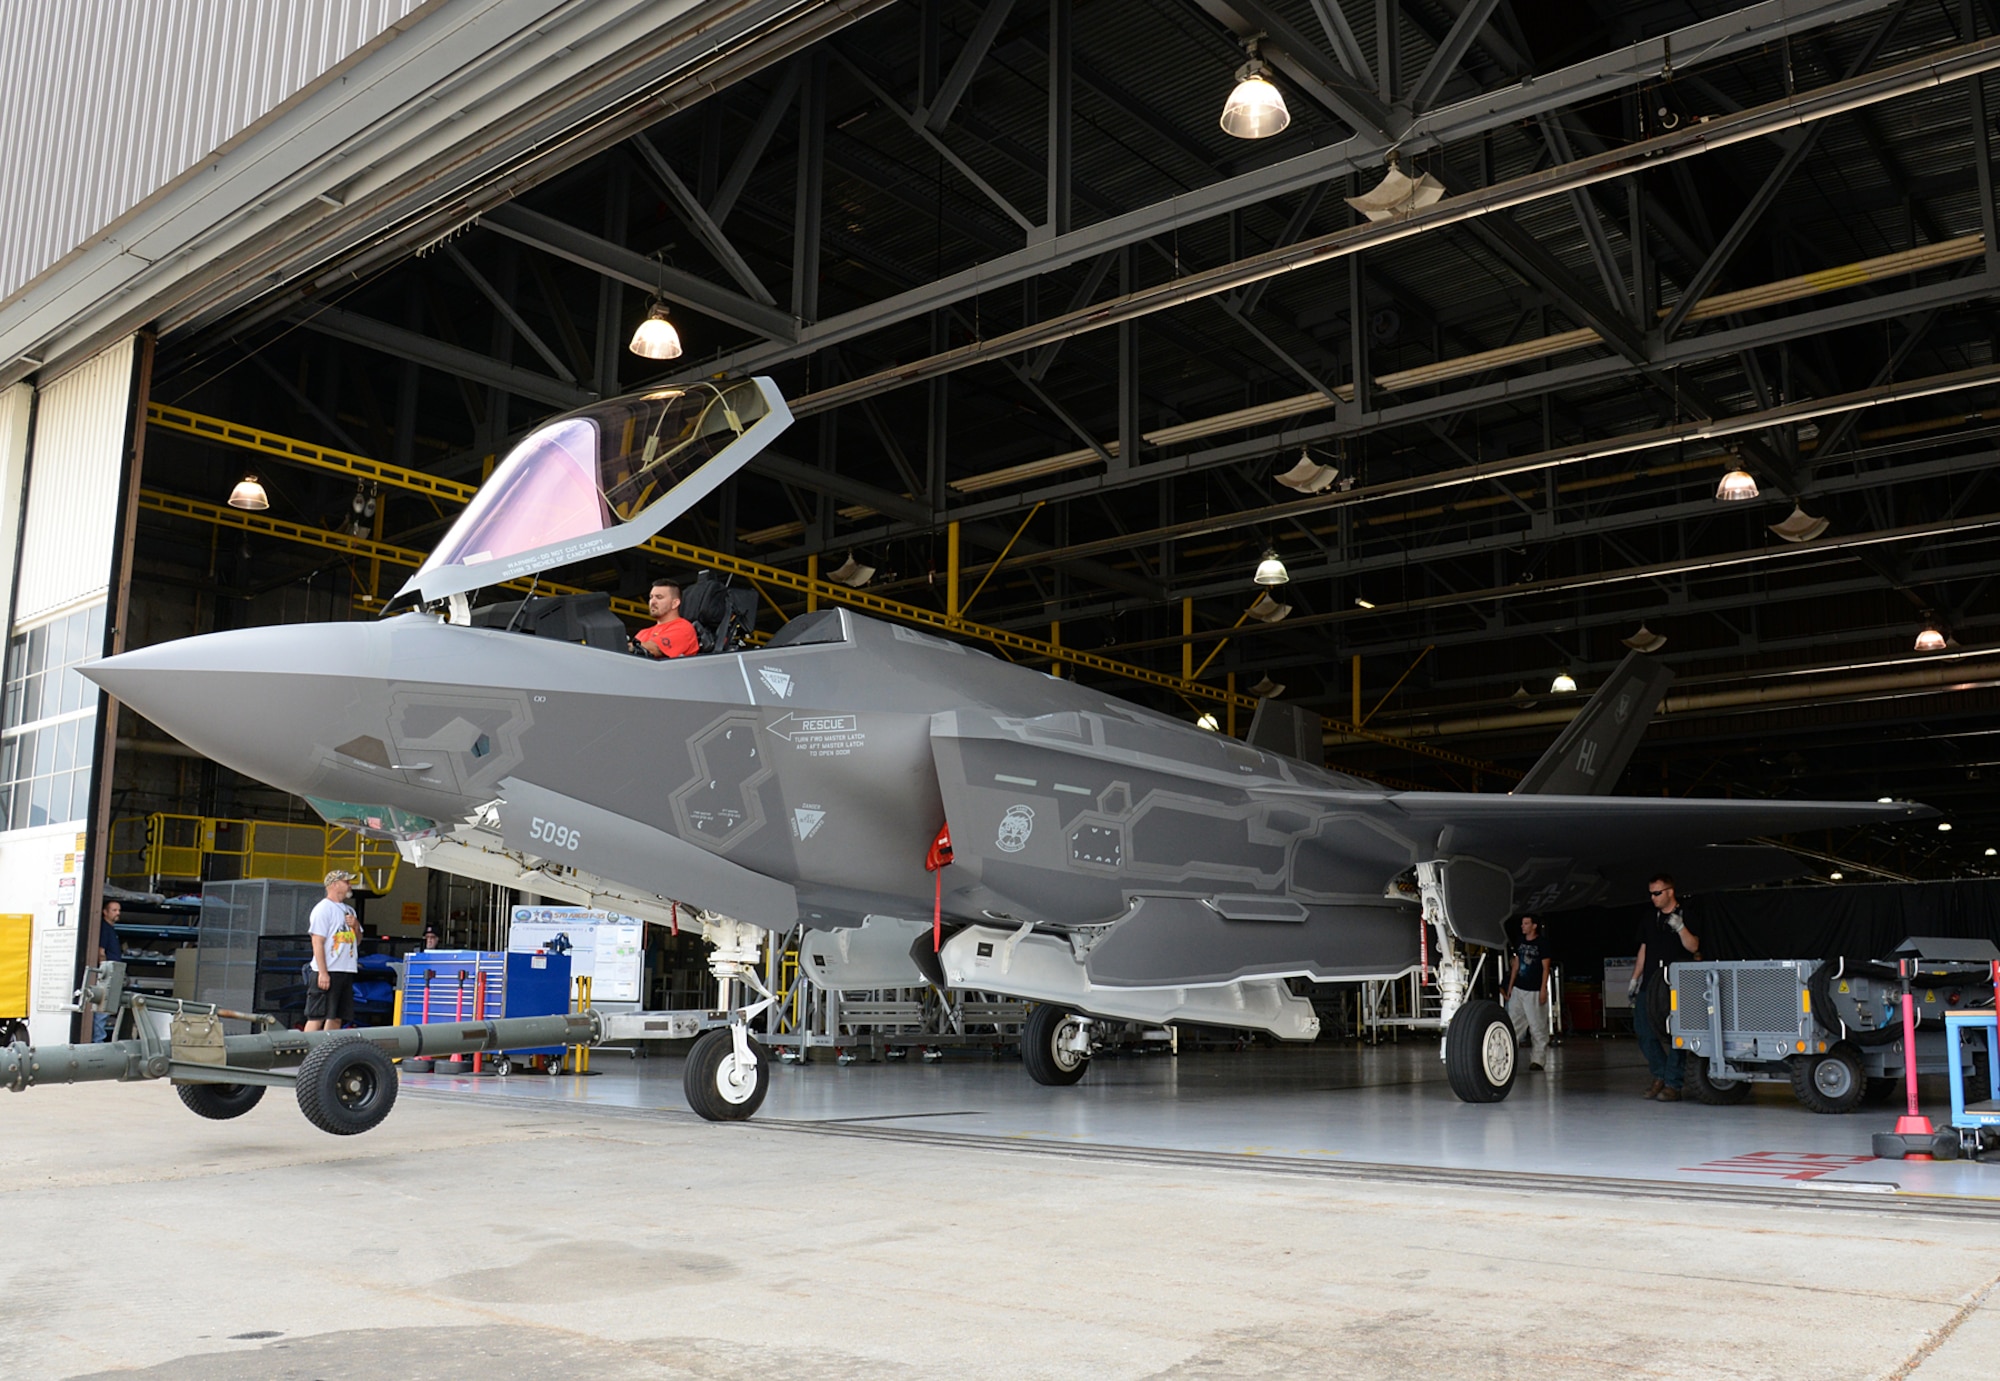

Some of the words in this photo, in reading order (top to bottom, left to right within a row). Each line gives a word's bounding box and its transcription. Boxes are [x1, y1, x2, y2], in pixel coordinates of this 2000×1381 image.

[579, 539, 603, 549] CANOPY
[503, 567, 524, 576] WITHIN
[533, 558, 555, 568] INCHES
[567, 549, 591, 559] CANOPY
[592, 543, 614, 553] FRAME
[802, 719, 844, 730] RESCUE
[1576, 739, 1597, 776] HL
[530, 816, 580, 851] 5096
[1678, 1152, 1879, 1180] EXIT
